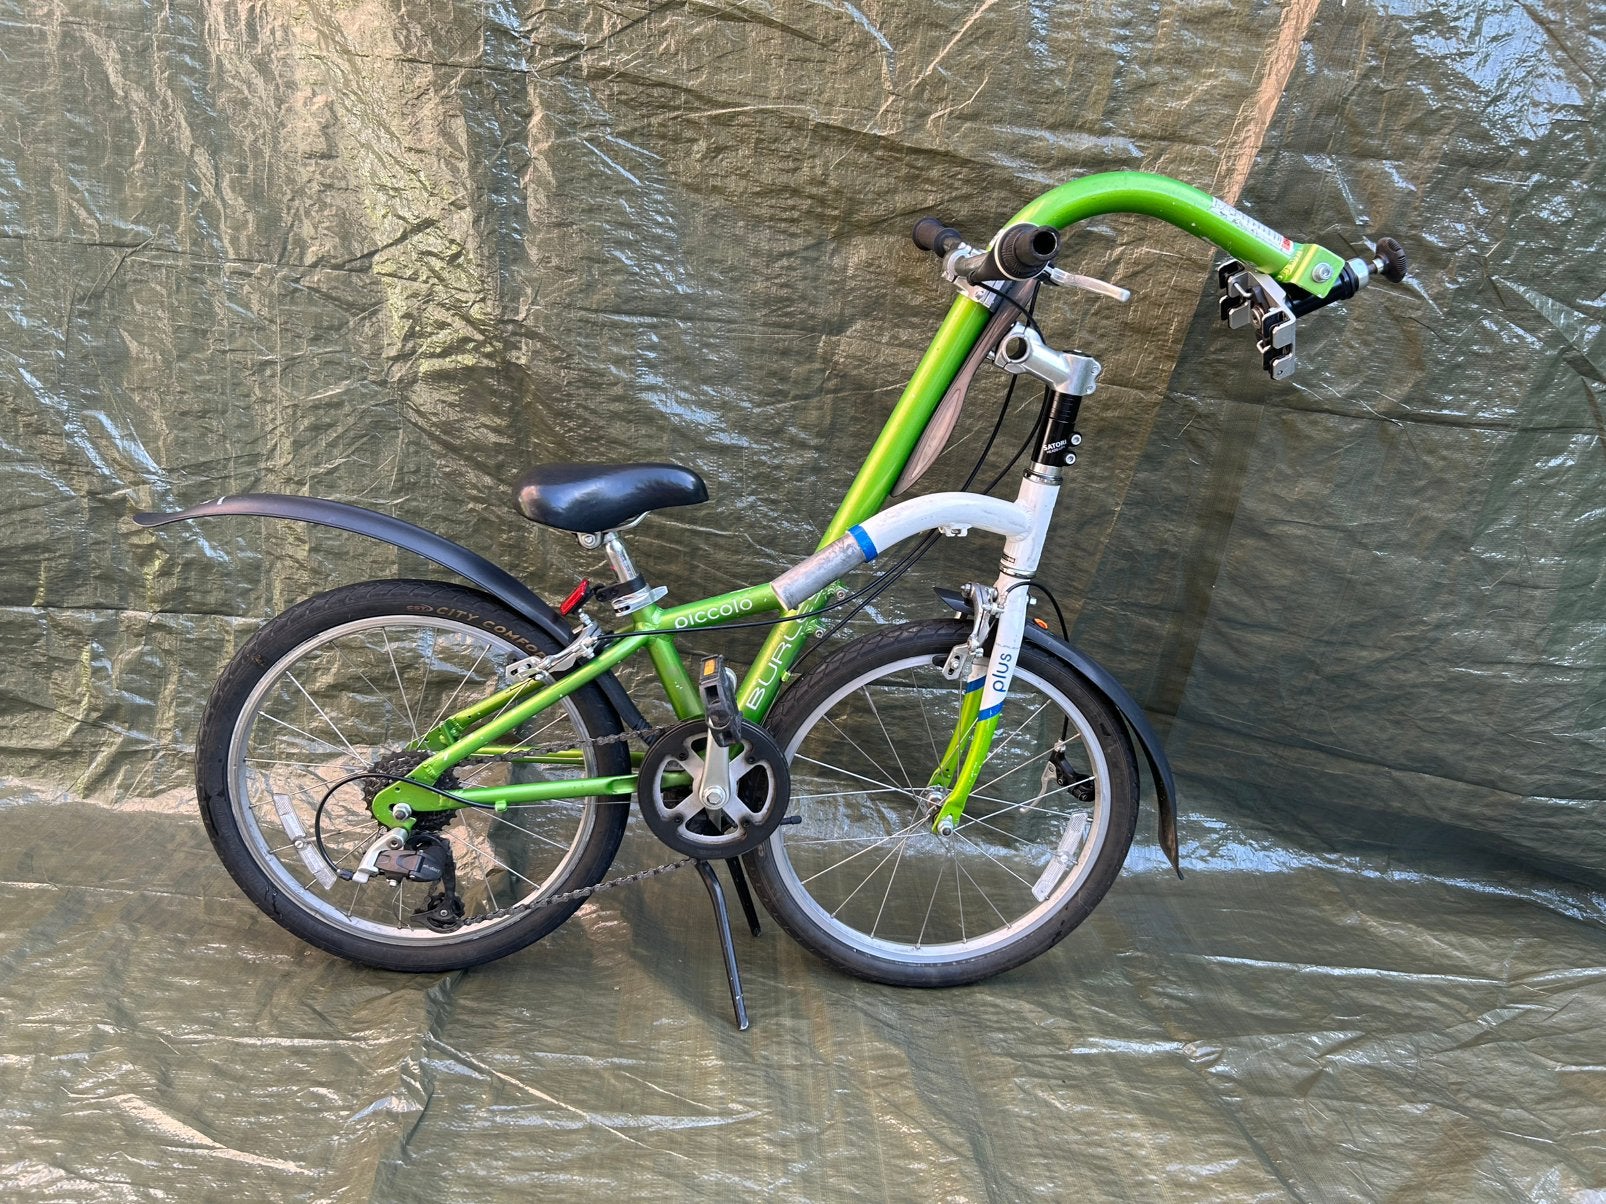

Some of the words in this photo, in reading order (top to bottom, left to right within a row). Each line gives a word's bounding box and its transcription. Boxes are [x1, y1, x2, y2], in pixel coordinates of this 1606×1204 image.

[1042, 439, 1067, 451] SATORI
[436, 606, 479, 622] CITY
[674, 598, 753, 629] piccolo
[992, 653, 1013, 693] plus
